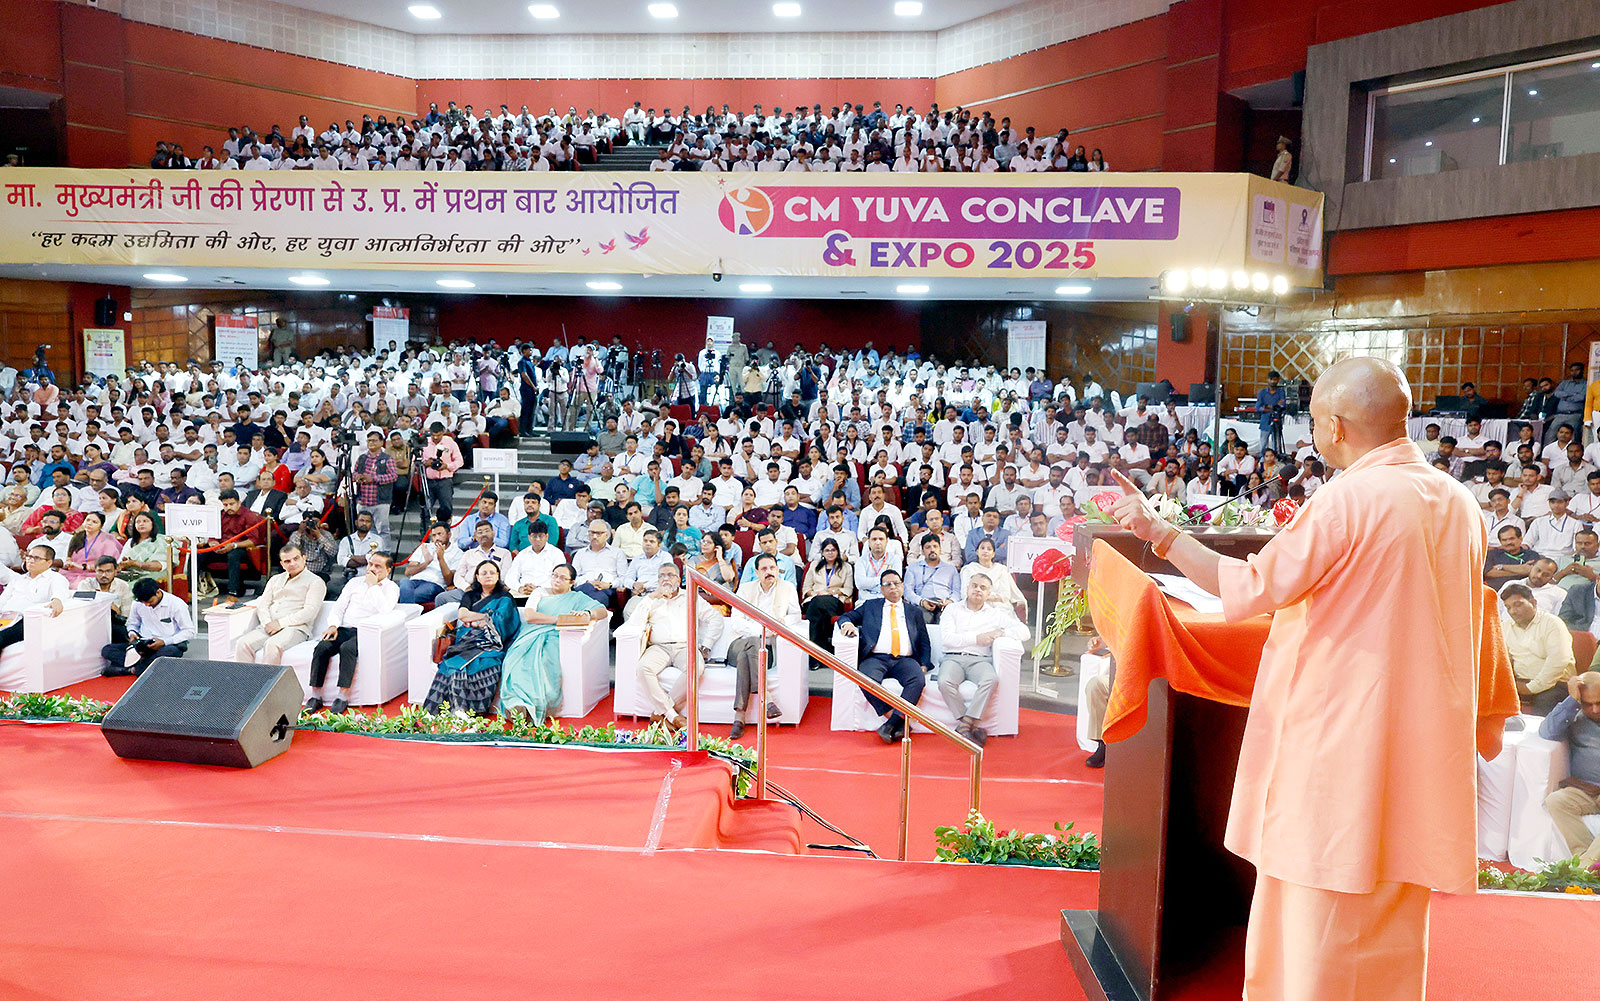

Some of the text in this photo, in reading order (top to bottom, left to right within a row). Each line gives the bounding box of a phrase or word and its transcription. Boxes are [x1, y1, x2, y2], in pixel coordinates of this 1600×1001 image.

[5, 184, 42, 207] मा.
[55, 178, 164, 217] मुख्यमंत्री
[170, 178, 203, 210] जी
[208, 178, 244, 211] की
[250, 180, 315, 212] प्रेरणा
[321, 181, 345, 212] से
[413, 181, 439, 213] में
[444, 189, 507, 213] प्रथम
[514, 189, 557, 213] बार
[566, 181, 680, 214] आयोजित
[784, 196, 1165, 224] CM YUVA CONCLAVE
[72, 232, 118, 248] कदम
[124, 230, 199, 249] उद्यमिता
[206, 230, 232, 250] की
[237, 231, 278, 253] ओर,
[286, 236, 312, 252] हर
[317, 237, 359, 258] युवा
[365, 233, 491, 254] आत्मनिर्भरता
[497, 233, 524, 254] की
[822, 233, 1096, 270] & EXPO 2025
